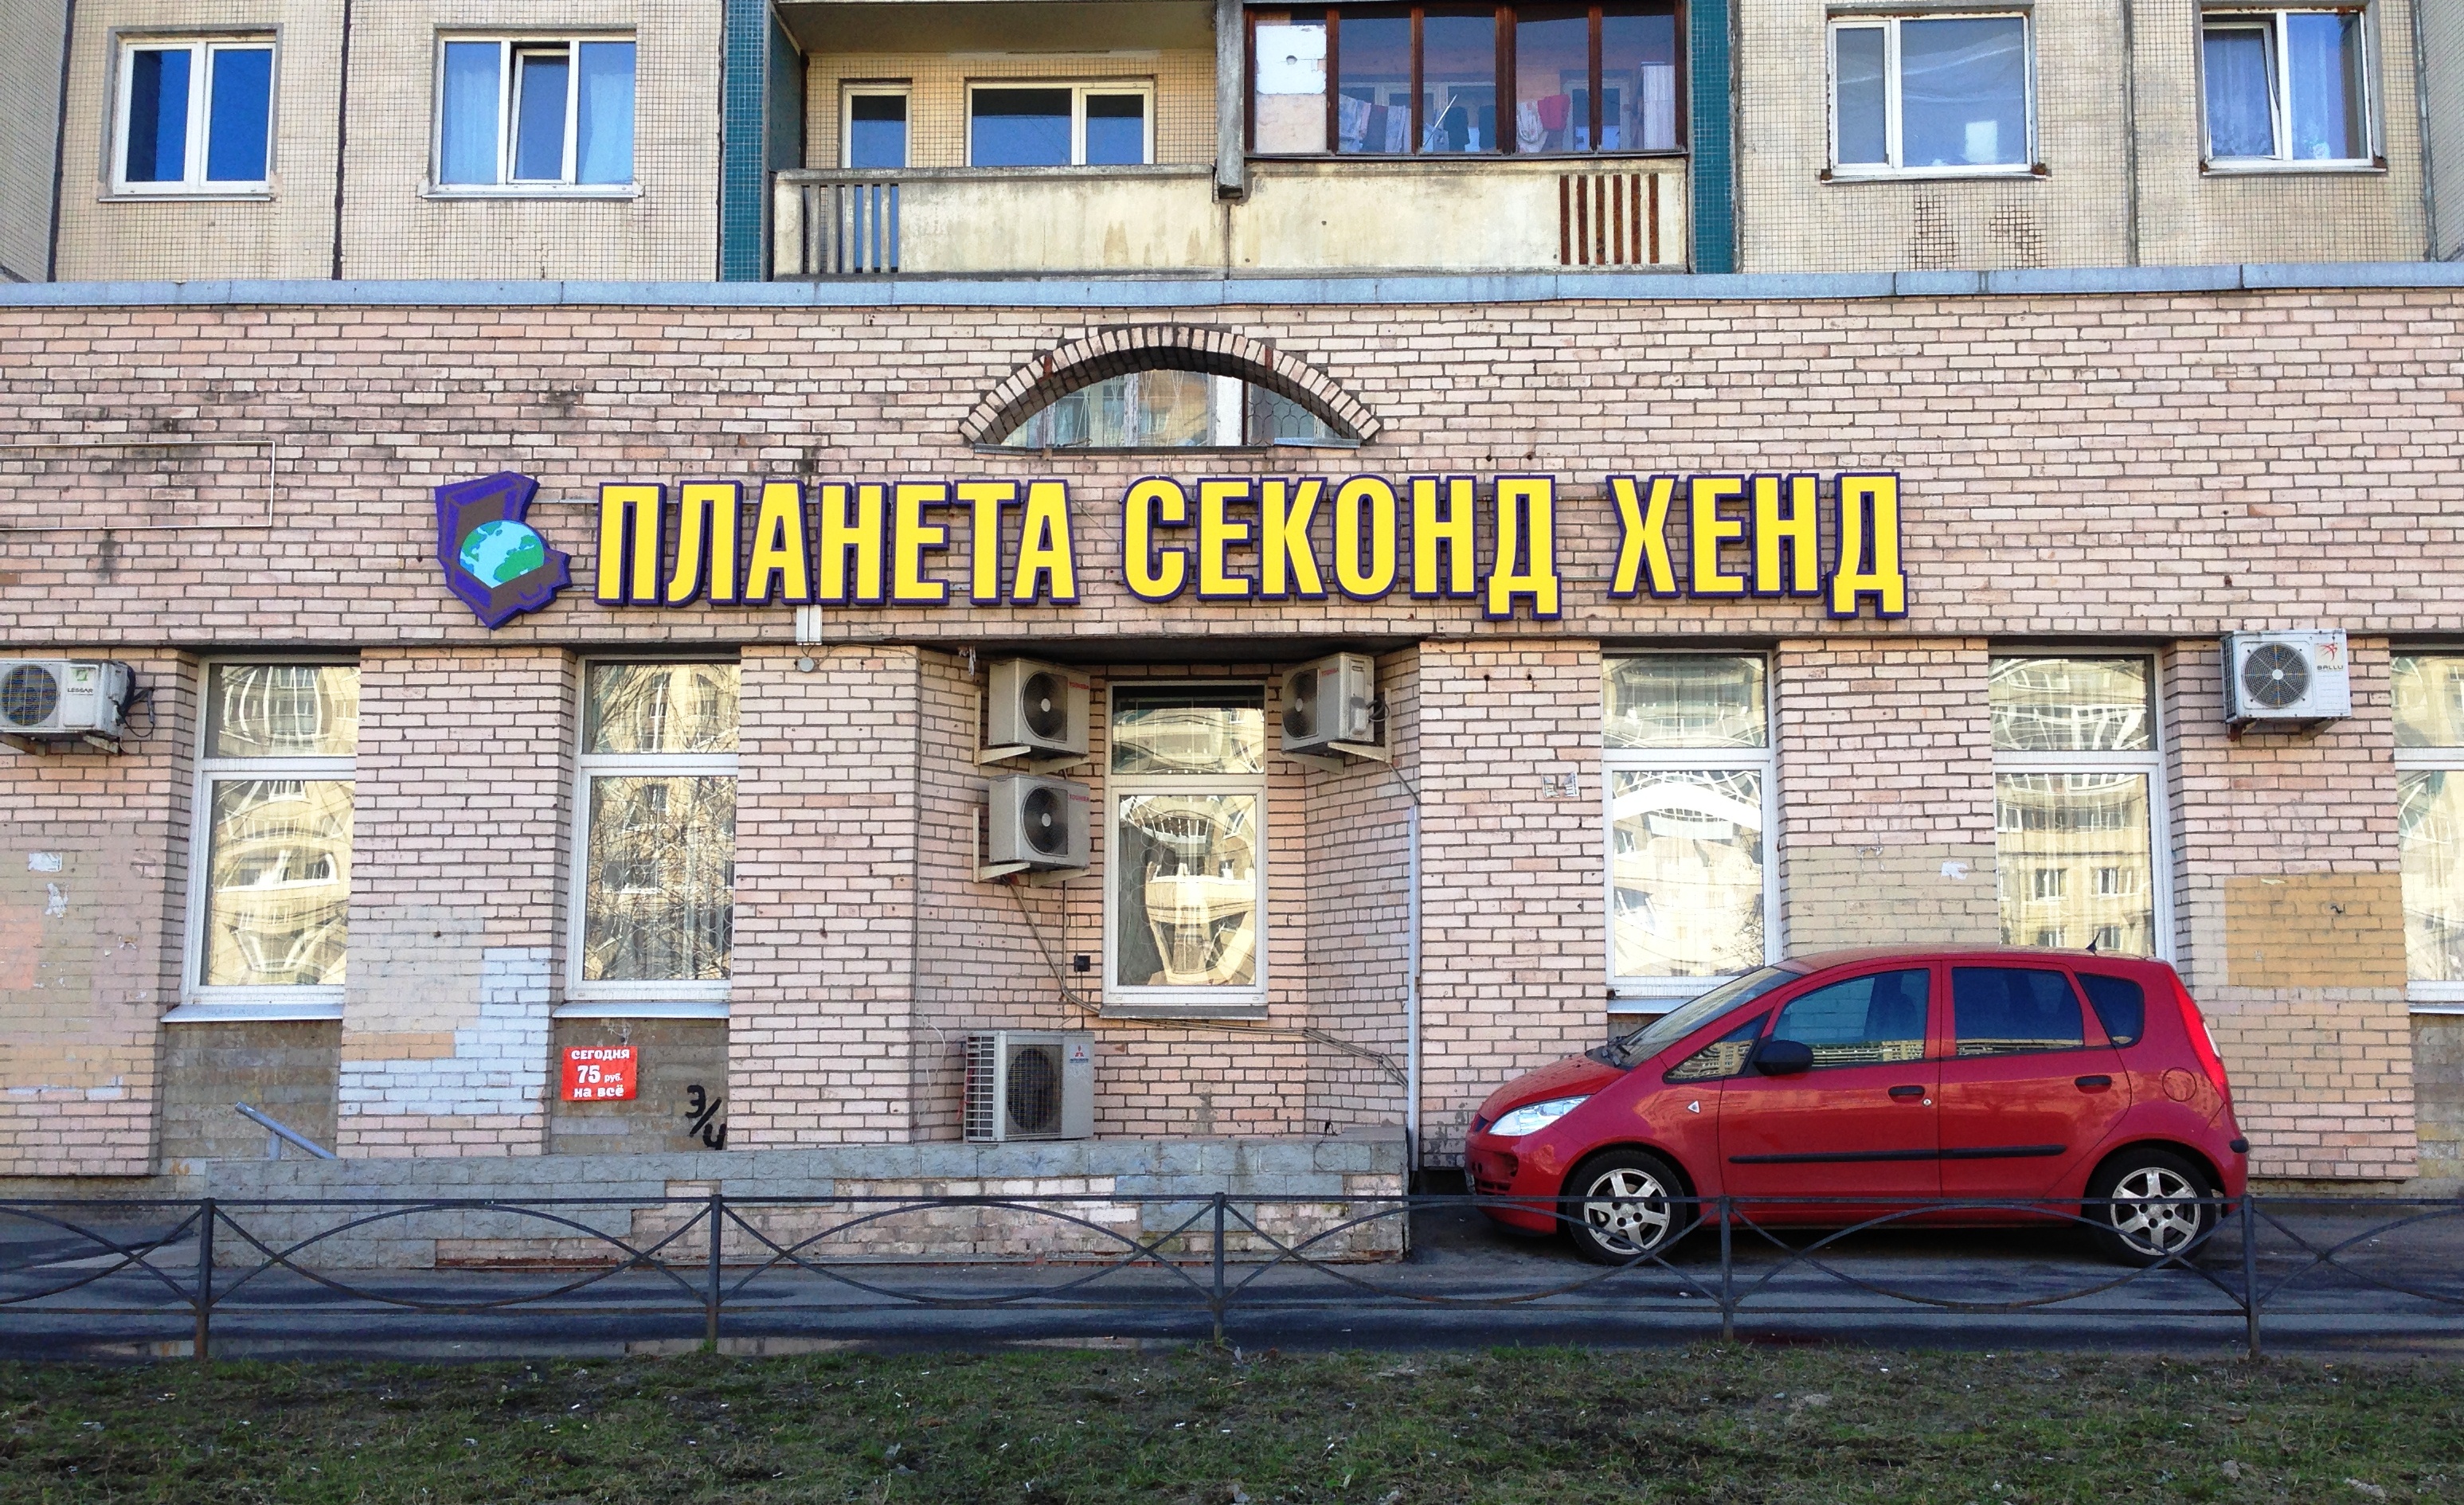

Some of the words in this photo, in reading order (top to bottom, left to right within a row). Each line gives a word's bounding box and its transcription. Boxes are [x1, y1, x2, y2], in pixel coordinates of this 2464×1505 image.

[595, 480, 1079, 607] ПЛАНЕТА
[1121, 475, 1562, 620] СЕКОНД
[1607, 473, 1908, 619] ХЕНД
[571, 1049, 630, 1061] СЕГОДНЯ
[577, 1065, 601, 1084] 75
[573, 1088, 592, 1098] на
[597, 1084, 624, 1097] всё
